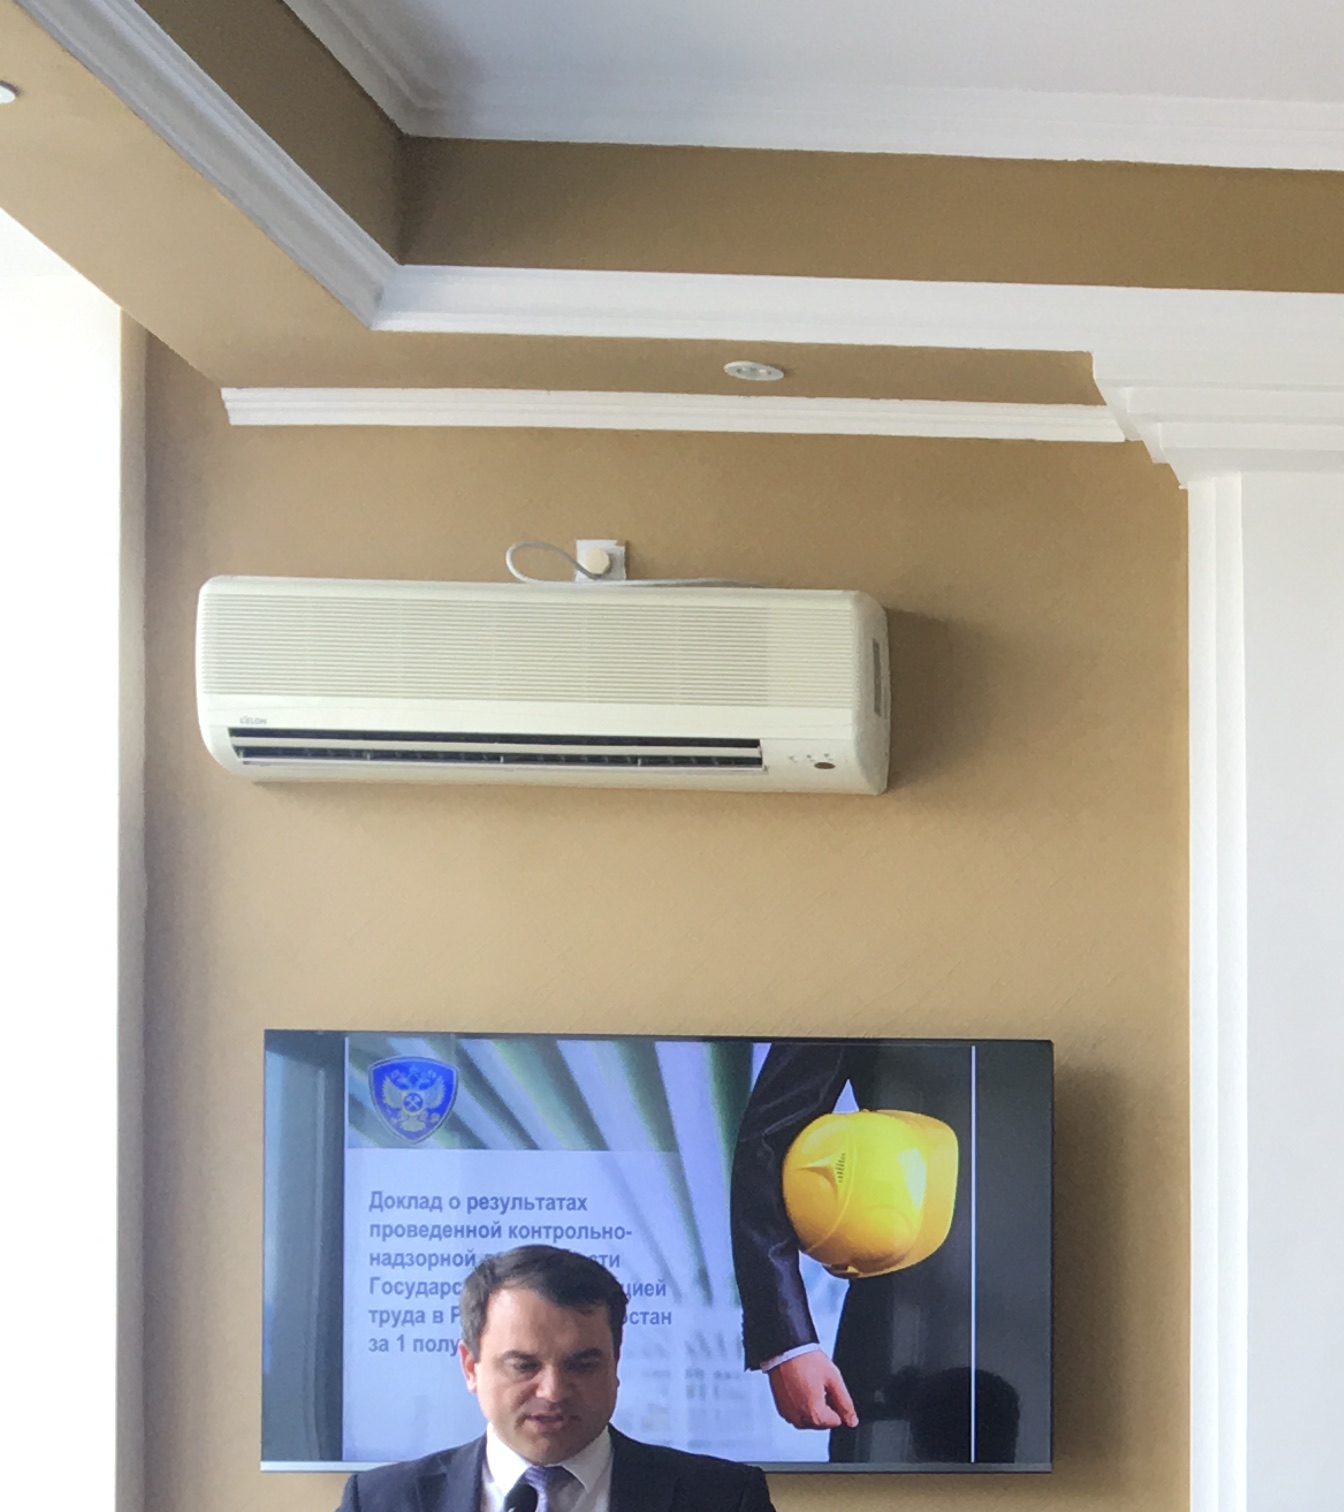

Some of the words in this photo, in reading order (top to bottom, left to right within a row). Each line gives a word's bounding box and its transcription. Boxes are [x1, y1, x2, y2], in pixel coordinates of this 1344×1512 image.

[368, 1191, 442, 1213] Доклад
[448, 1197, 460, 1211] о
[467, 1196, 587, 1214] результатах
[369, 1221, 501, 1241] проведенной
[508, 1225, 632, 1243] контрольно-
[369, 1250, 475, 1272] надзорной
[369, 1277, 463, 1299] Государс
[368, 1309, 425, 1327] труда
[432, 1309, 444, 1323] в
[369, 1337, 389, 1352] за
[397, 1334, 405, 1351] 1
